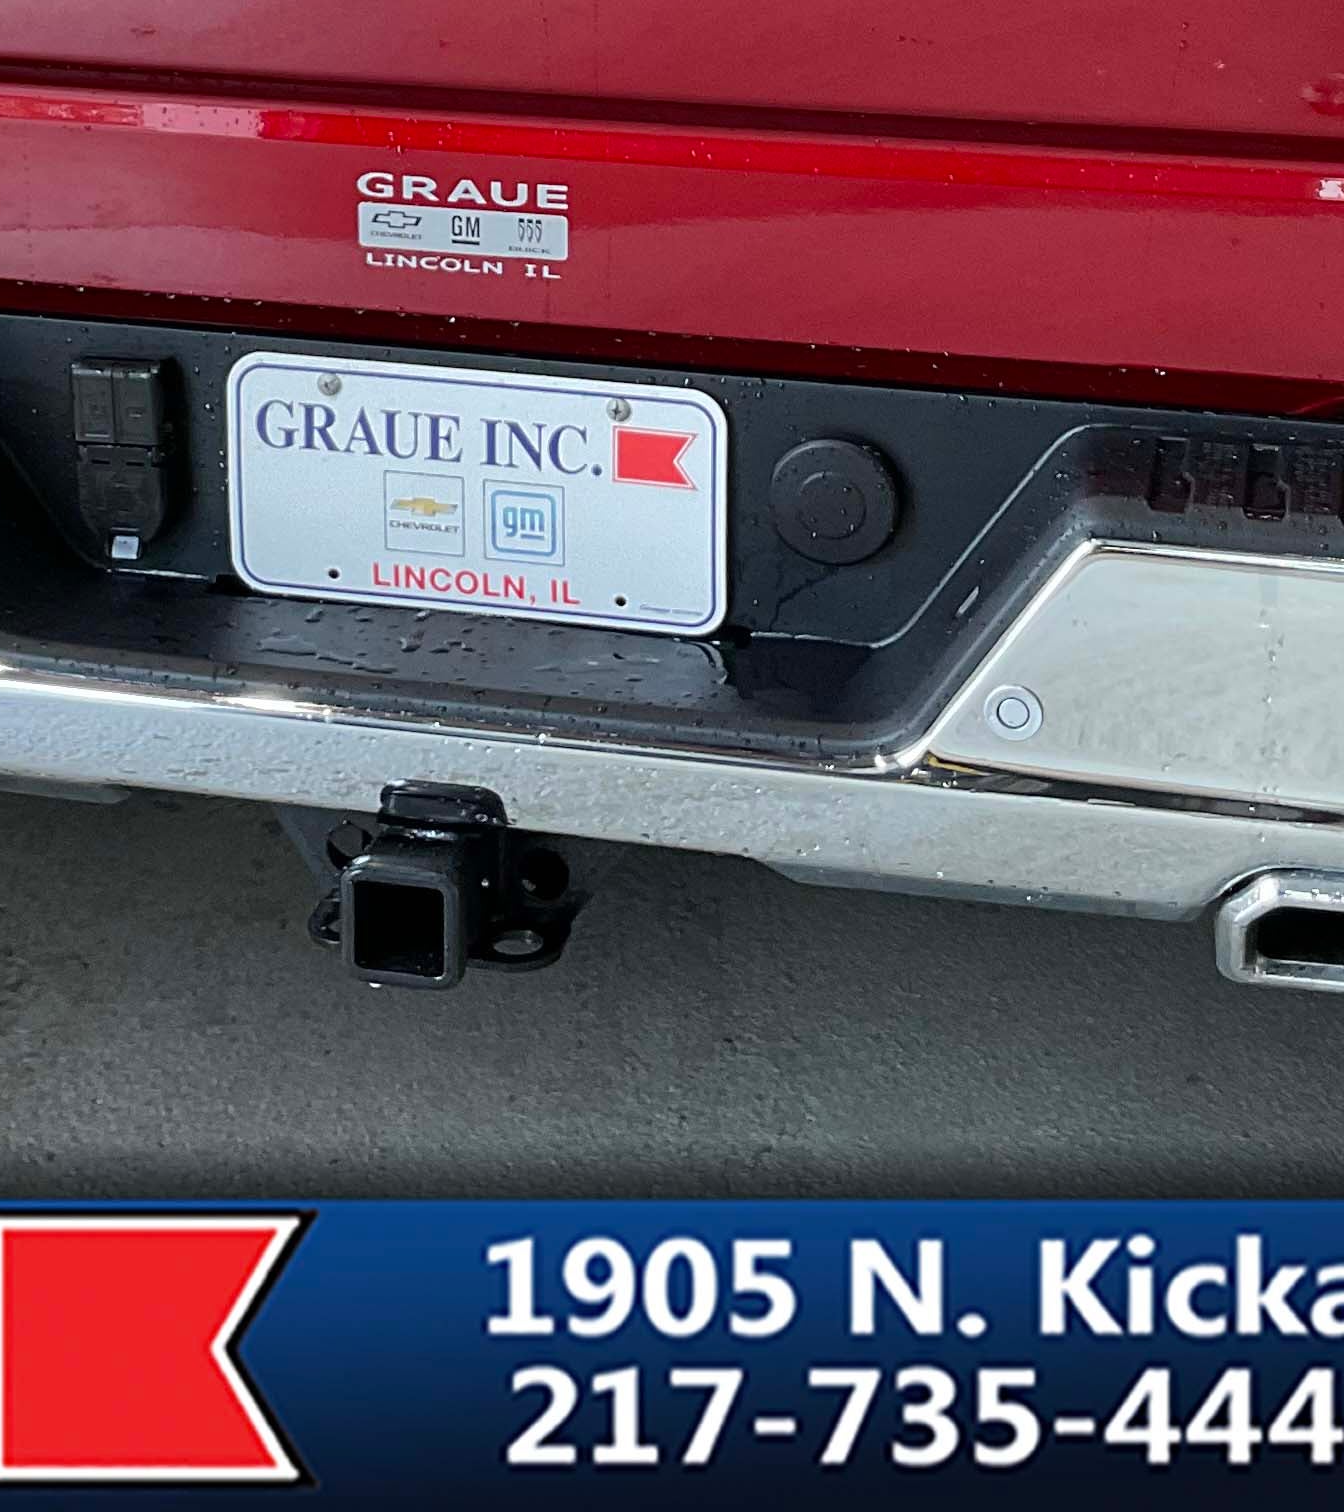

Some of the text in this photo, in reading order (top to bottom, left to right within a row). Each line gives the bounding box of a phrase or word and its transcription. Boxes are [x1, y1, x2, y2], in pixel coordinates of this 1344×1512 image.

[356, 172, 569, 210] GRAUE
[451, 215, 480, 240] GM
[366, 252, 562, 279] LINCOLN IL
[255, 399, 604, 477] GRAUE INC.
[389, 519, 460, 534] CHEVROLET
[502, 506, 545, 538] gm
[372, 562, 581, 605] LINCOLN, IL
